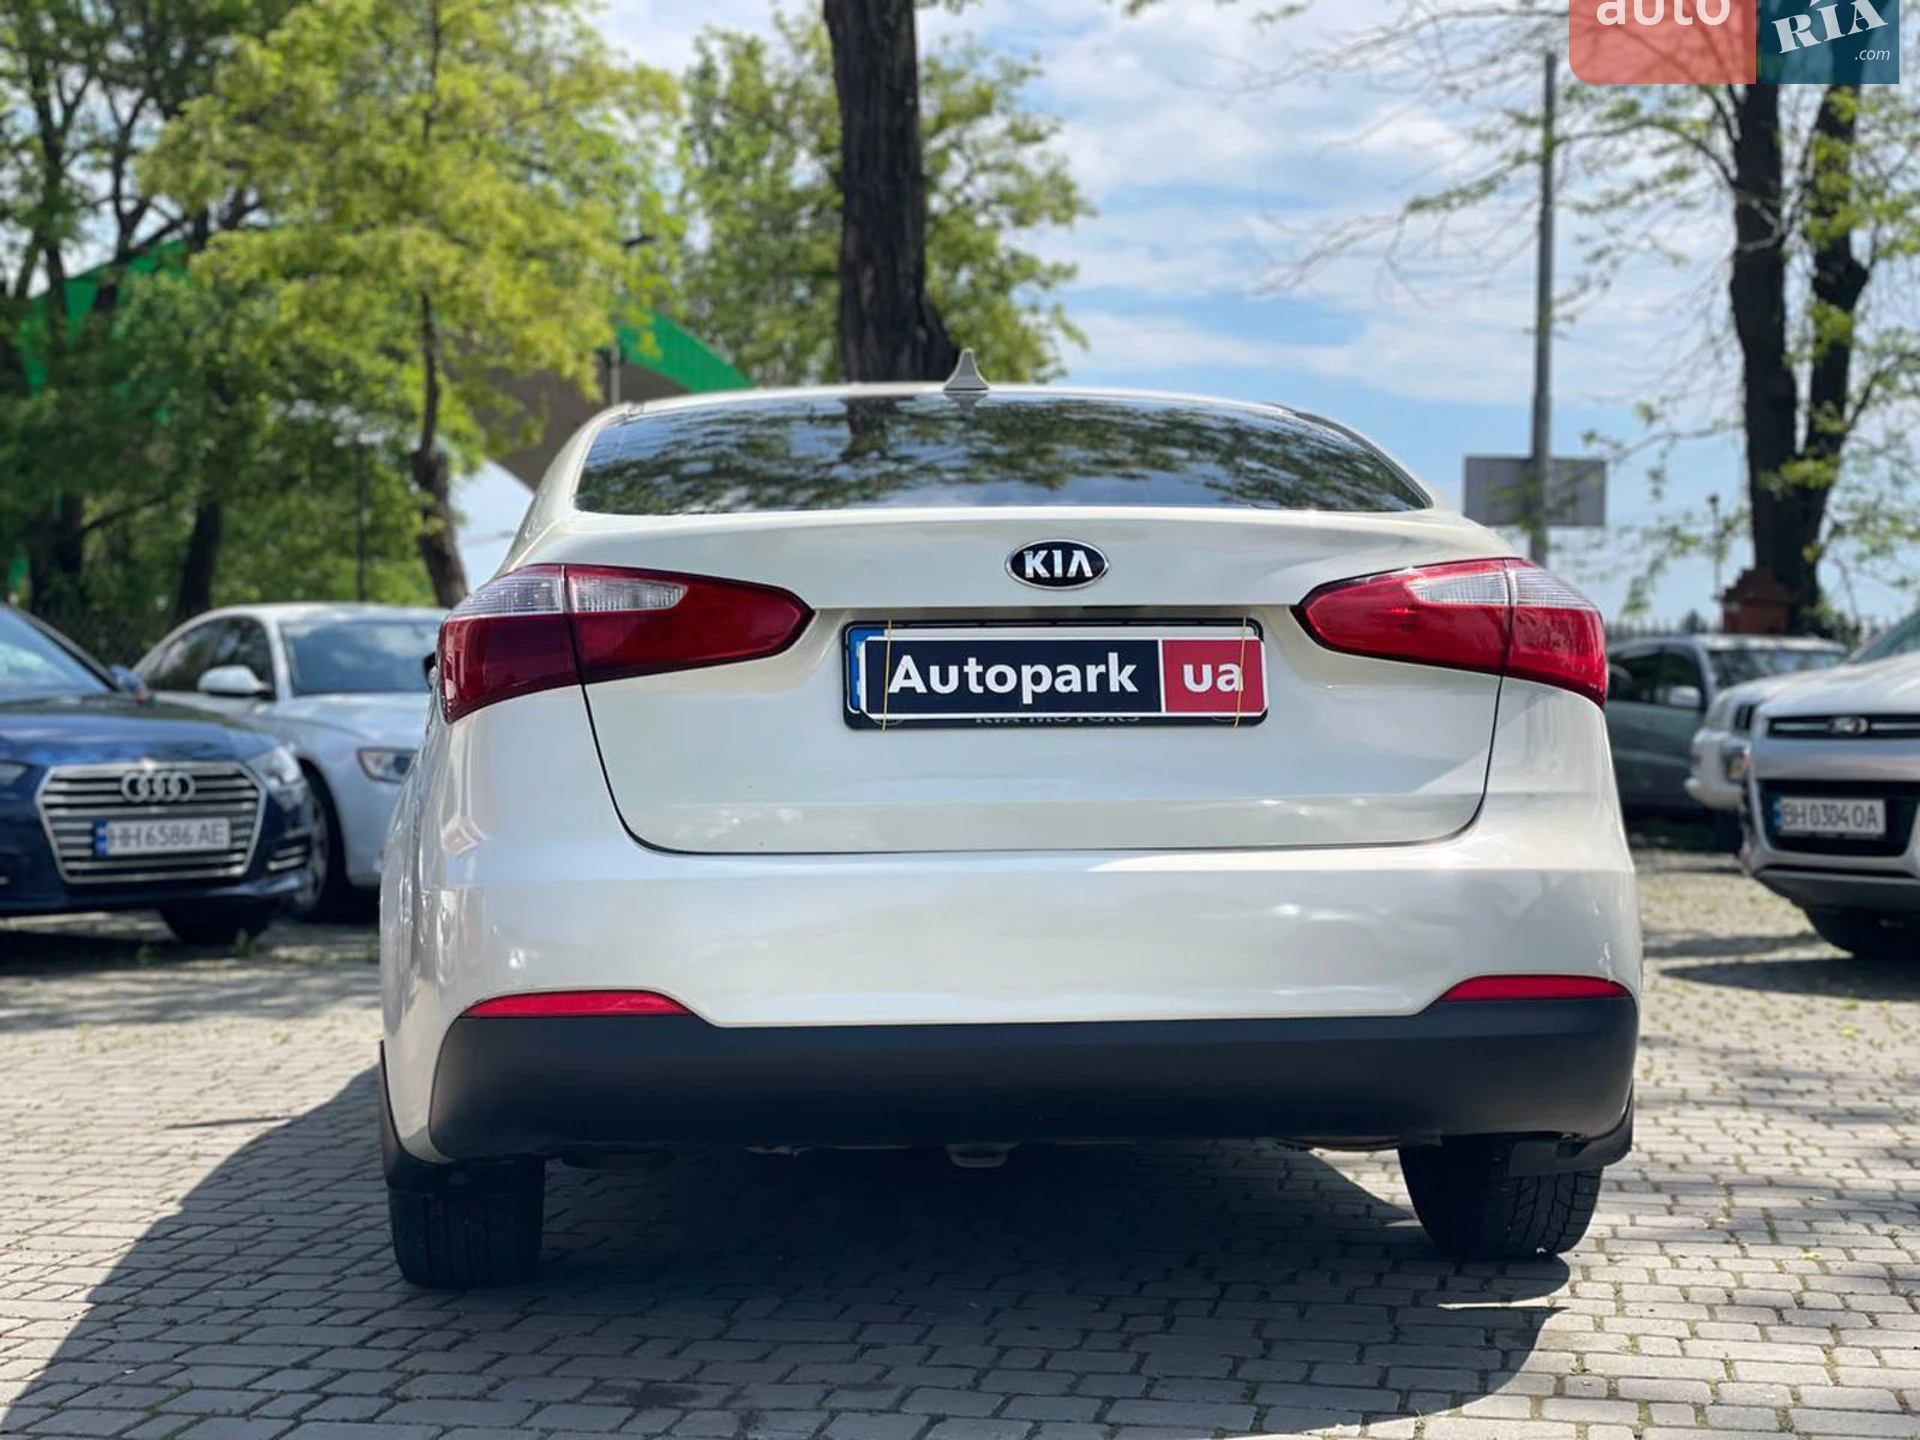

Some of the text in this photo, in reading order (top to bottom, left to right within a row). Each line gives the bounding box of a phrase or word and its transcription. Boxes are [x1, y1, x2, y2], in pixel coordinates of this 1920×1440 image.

[1023, 550, 1093, 578] KIA
[888, 652, 1244, 704] Autopark ua
